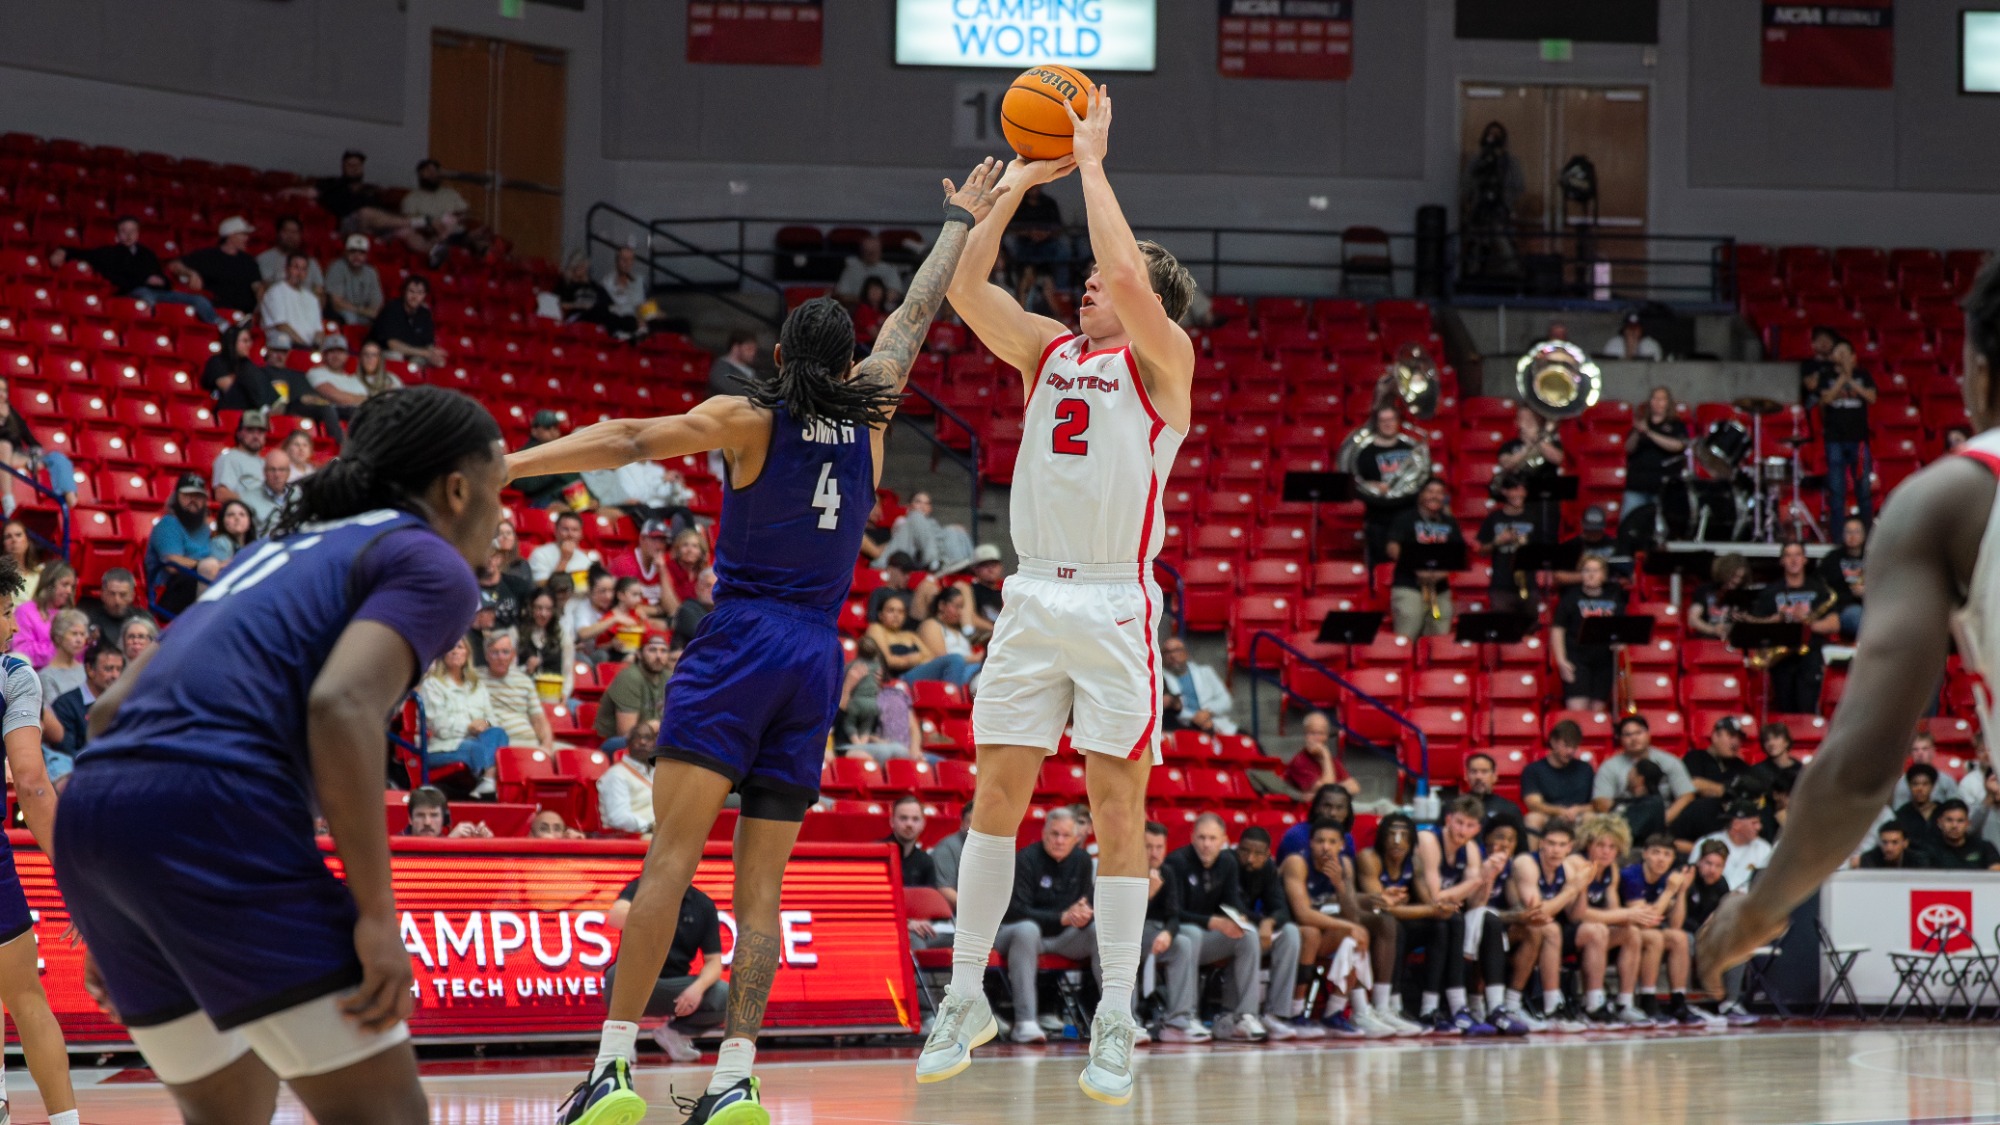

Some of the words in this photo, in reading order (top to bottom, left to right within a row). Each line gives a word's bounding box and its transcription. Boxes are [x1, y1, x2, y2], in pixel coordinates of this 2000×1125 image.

[953, 0, 1102, 23] CAMPING
[953, 24, 1102, 58] WORLD
[963, 92, 1003, 141] 1
[1077, 376, 1119, 393] TECH
[1052, 398, 1090, 456] 2
[811, 462, 841, 530] 4
[400, 910, 612, 967] AMPUS
[433, 977, 504, 998] TECH
[516, 976, 606, 998] UNIVE
